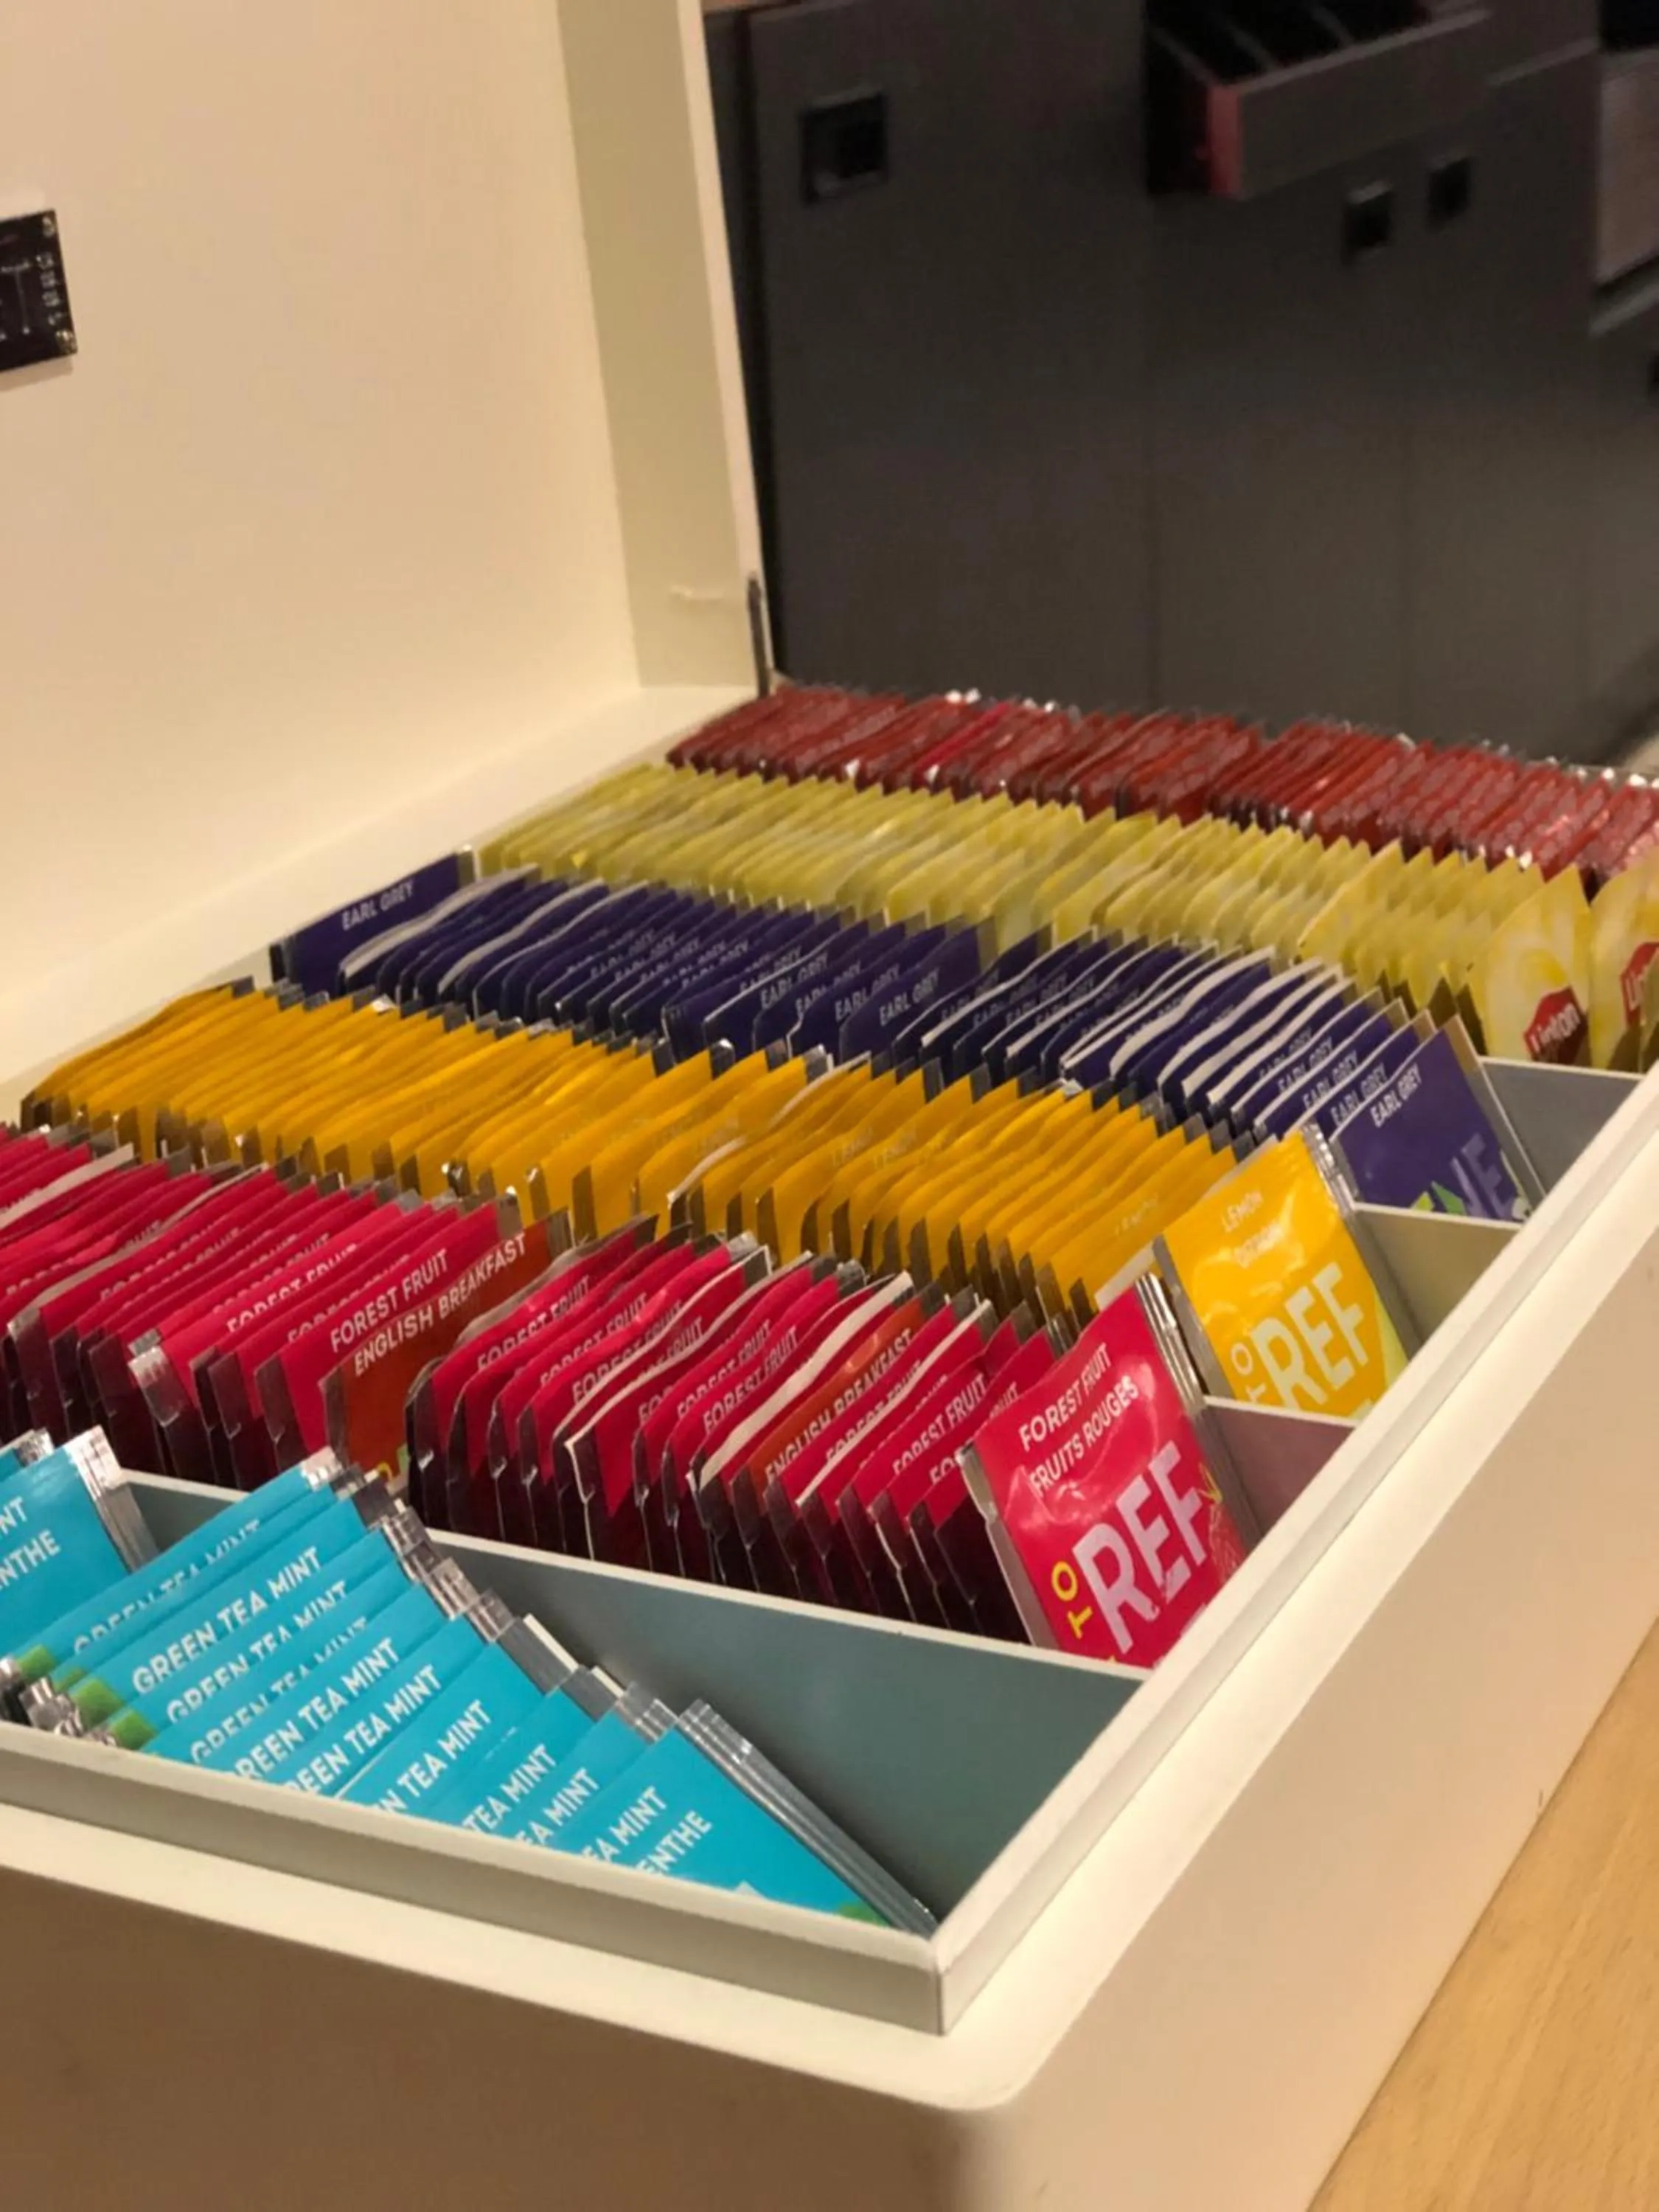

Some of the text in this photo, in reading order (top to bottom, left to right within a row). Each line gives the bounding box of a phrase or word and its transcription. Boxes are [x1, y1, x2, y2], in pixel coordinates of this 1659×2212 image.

[342, 881, 412, 931] EARL GREY
[879, 992, 911, 1027] EARL
[911, 967, 940, 1004] GREY
[1370, 1062, 1422, 1129] EARL GREY
[330, 1287, 398, 1352] FOREST
[401, 1248, 448, 1301] FRUIT
[354, 1306, 434, 1377] ENGLISH
[438, 1233, 527, 1318] BREAKFAST
[1251, 1262, 1369, 1410] REF
[703, 1365, 763, 1436] FOREST
[763, 1326, 799, 1382] FRUIT
[765, 1413, 832, 1481] ENGLISH
[834, 1329, 914, 1416] BREAKFAST
[945, 1373, 988, 1428] FRUIT
[1018, 1343, 1111, 1452] FOREST FRUIT
[1029, 1374, 1139, 1498] FRUITS ROUGES
[0, 1496, 28, 1535] NT
[0, 1529, 61, 1591] NTHE
[1072, 1440, 1208, 1654] REF
[133, 1546, 322, 1694] GREEN TEA MINT
[1051, 1560, 1093, 1639] TO
[167, 1580, 347, 1723] GREEN TEA MINT
[234, 1638, 400, 1780] REEN TEA MINT
[286, 1664, 441, 1795] EEN TEA MINT
[397, 1699, 491, 1798] TEA MINT
[461, 1795, 512, 1833] TEA
[500, 1743, 556, 1804] MINT
[515, 1767, 599, 1845] EA MINT
[580, 1786, 667, 1863] EA MINT
[636, 1811, 713, 1874] ENTHE
